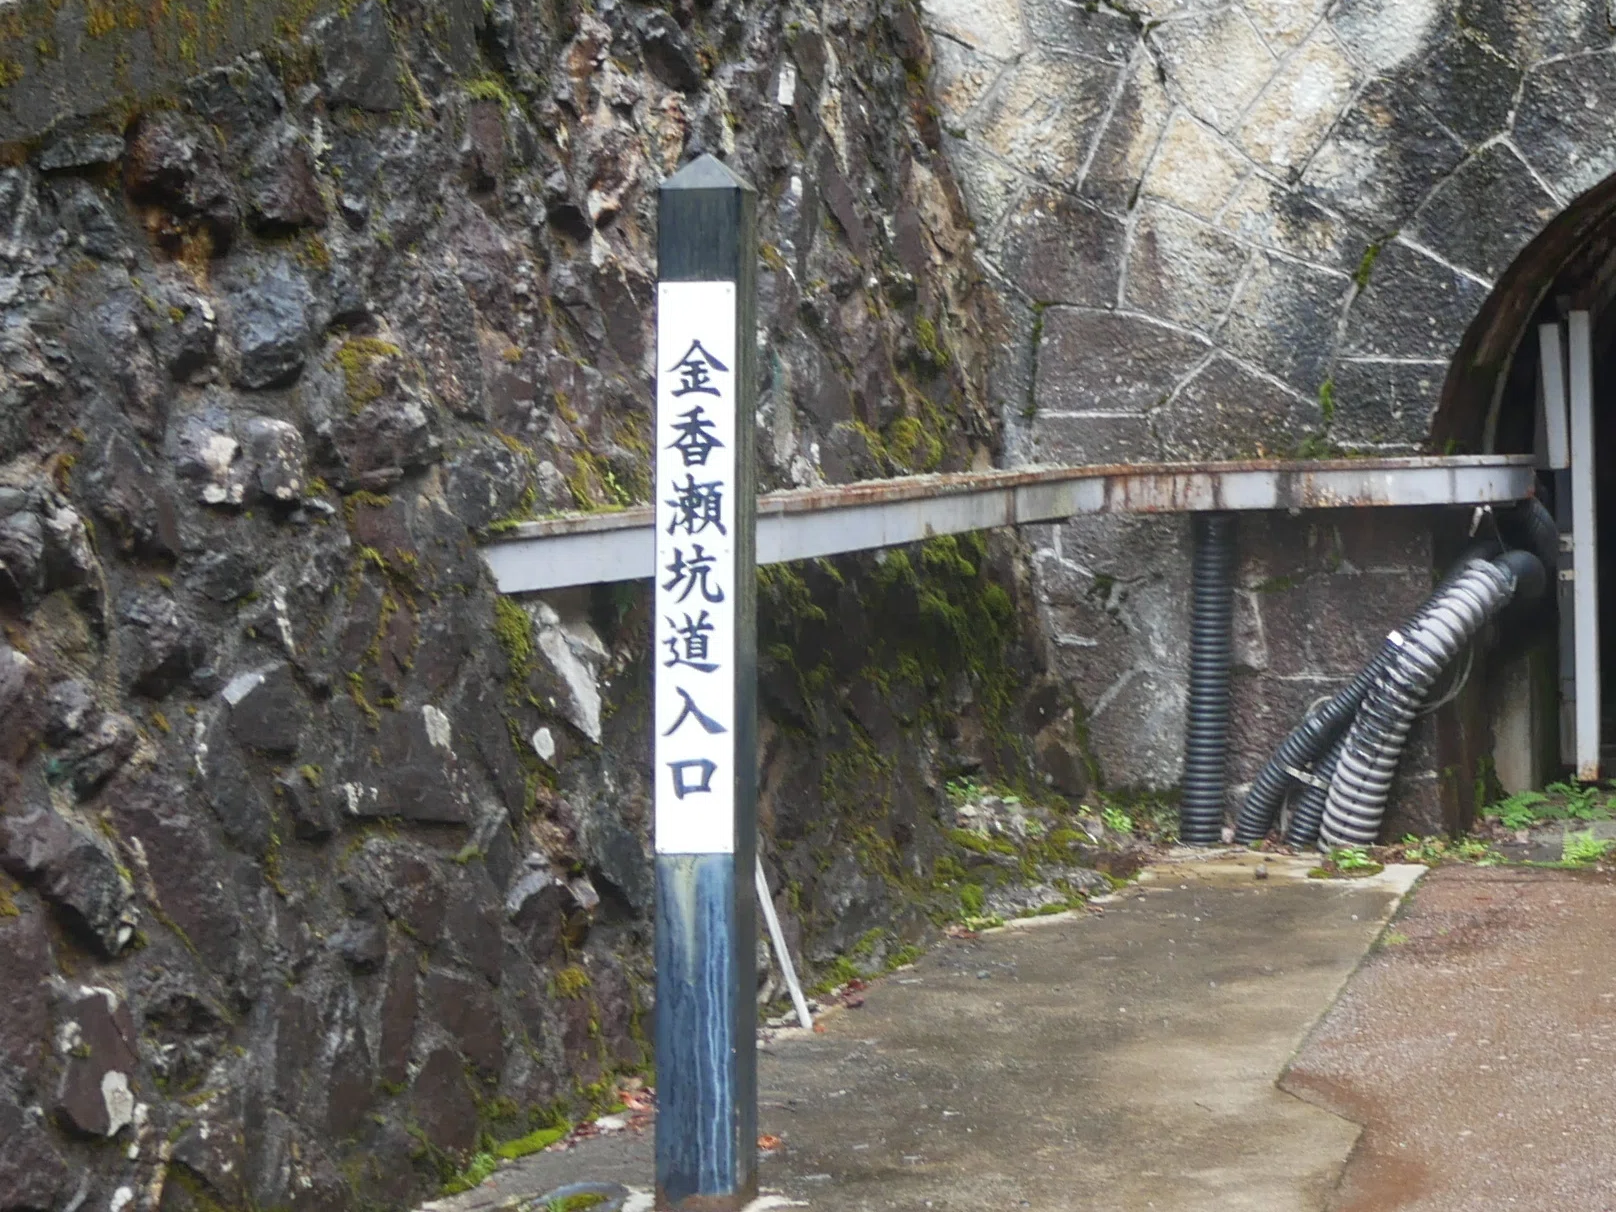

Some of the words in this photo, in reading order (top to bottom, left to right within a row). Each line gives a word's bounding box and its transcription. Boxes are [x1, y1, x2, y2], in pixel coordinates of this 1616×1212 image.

[661, 338, 730, 801] 金香瀬坑道入口
